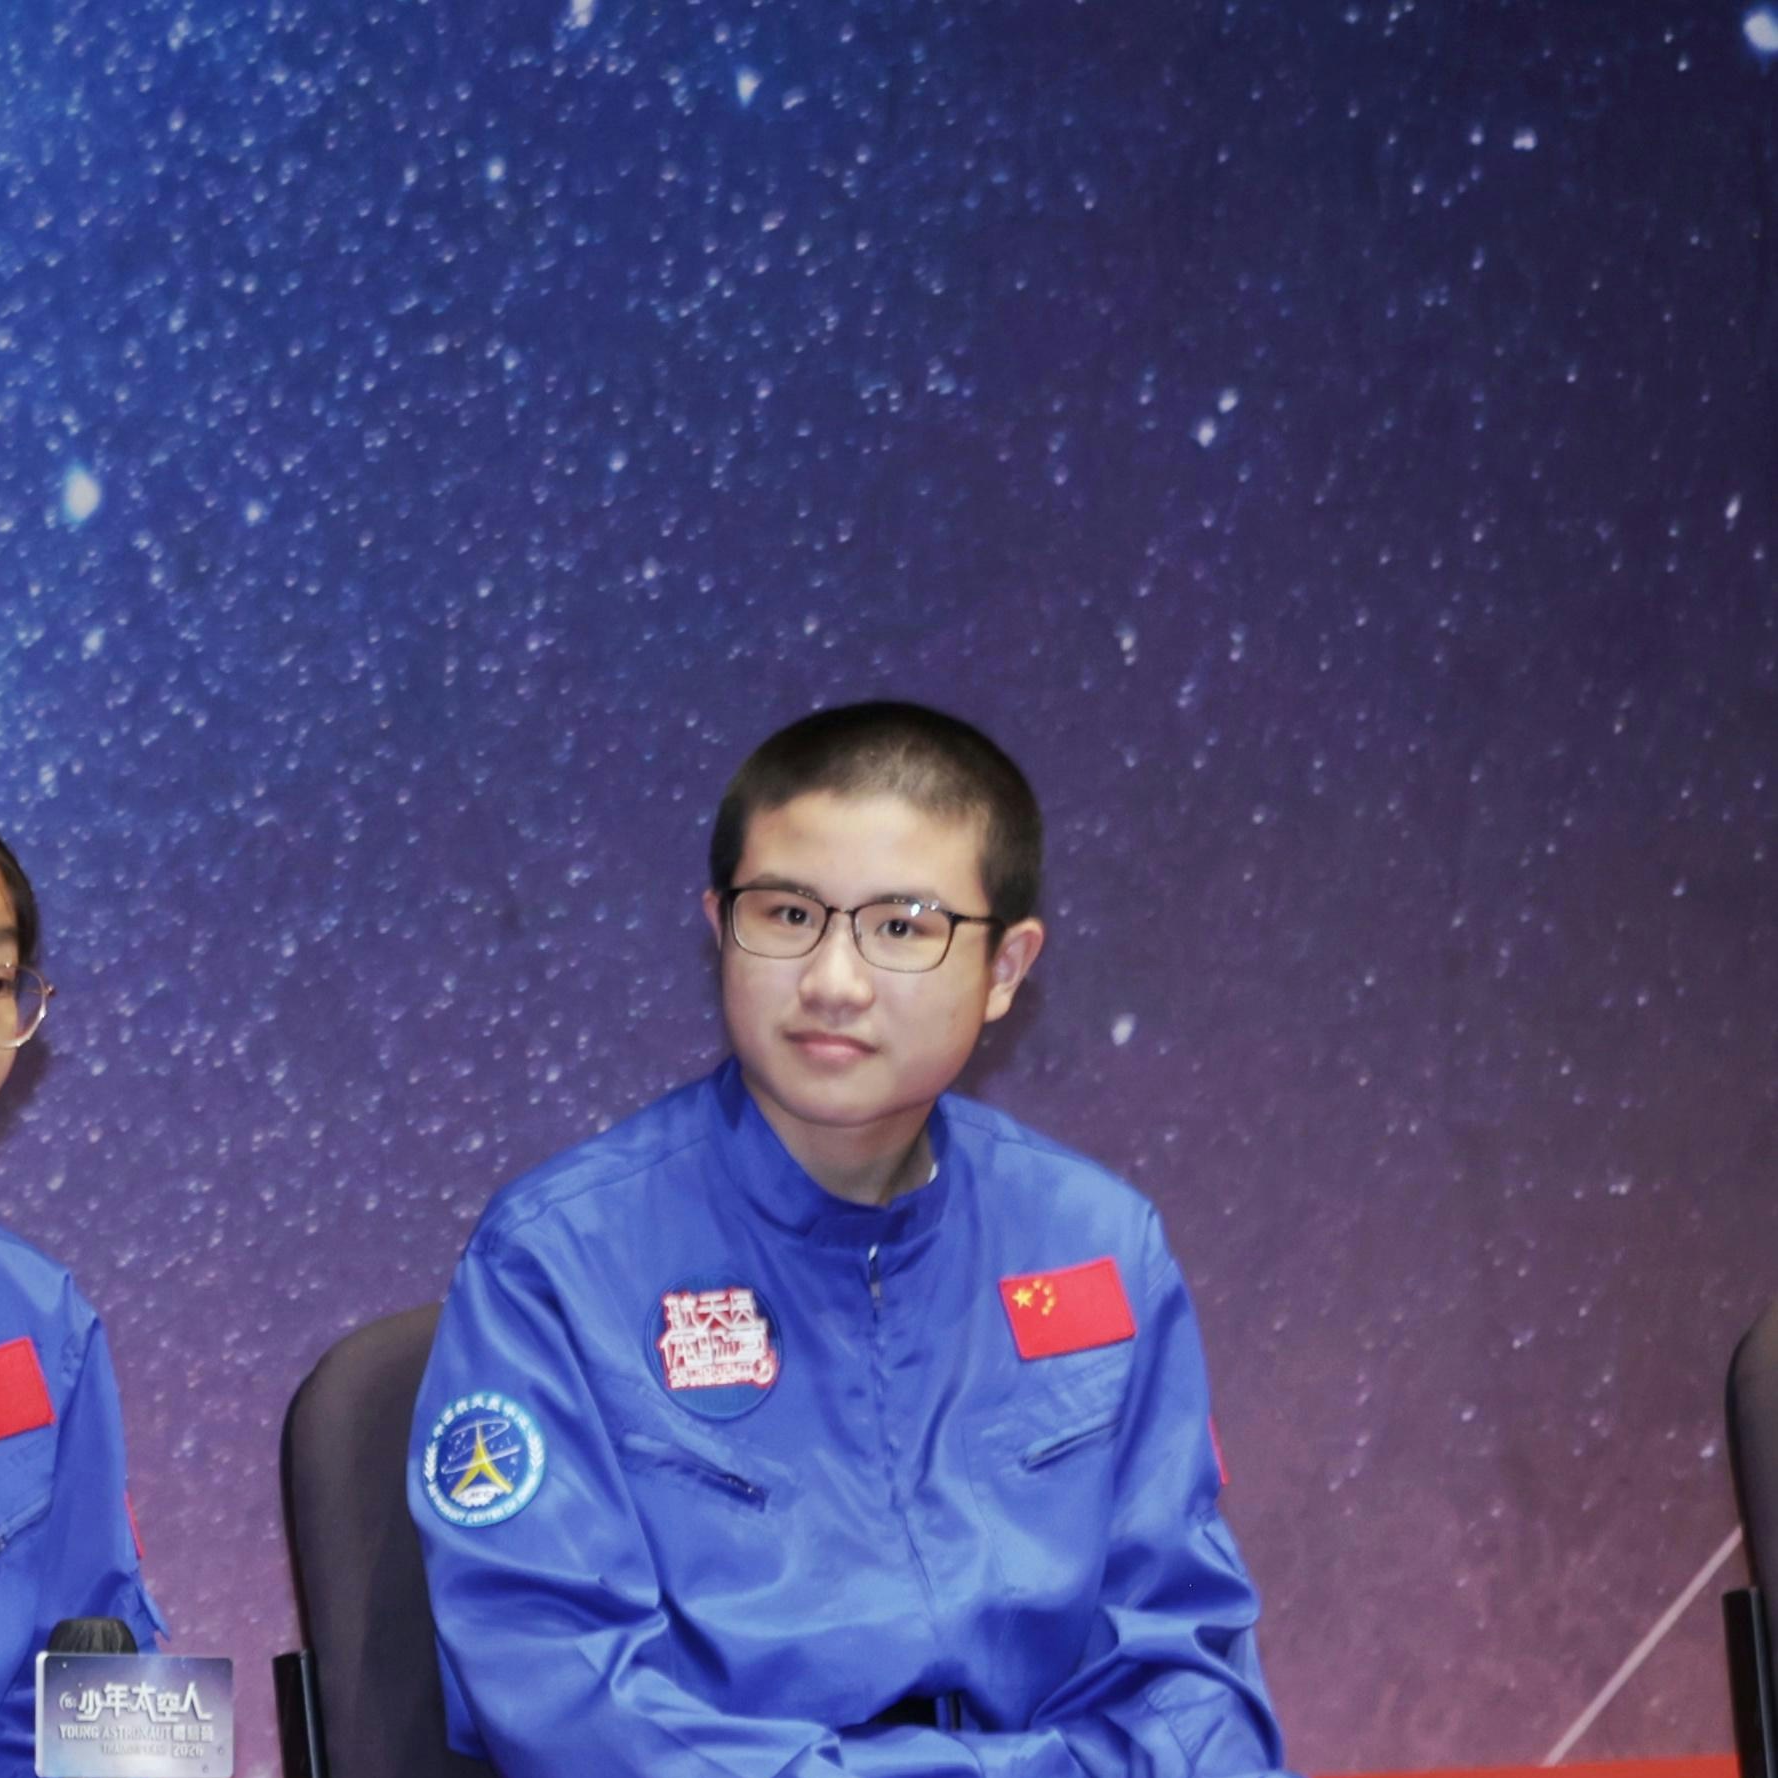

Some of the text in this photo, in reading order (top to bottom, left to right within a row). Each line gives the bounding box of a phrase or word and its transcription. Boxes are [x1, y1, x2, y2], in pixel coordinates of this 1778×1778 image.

[75, 1681, 214, 1723] 少年太空人
[59, 1724, 99, 1740] YOUNG
[101, 1724, 172, 1741] ASTRONAUT
